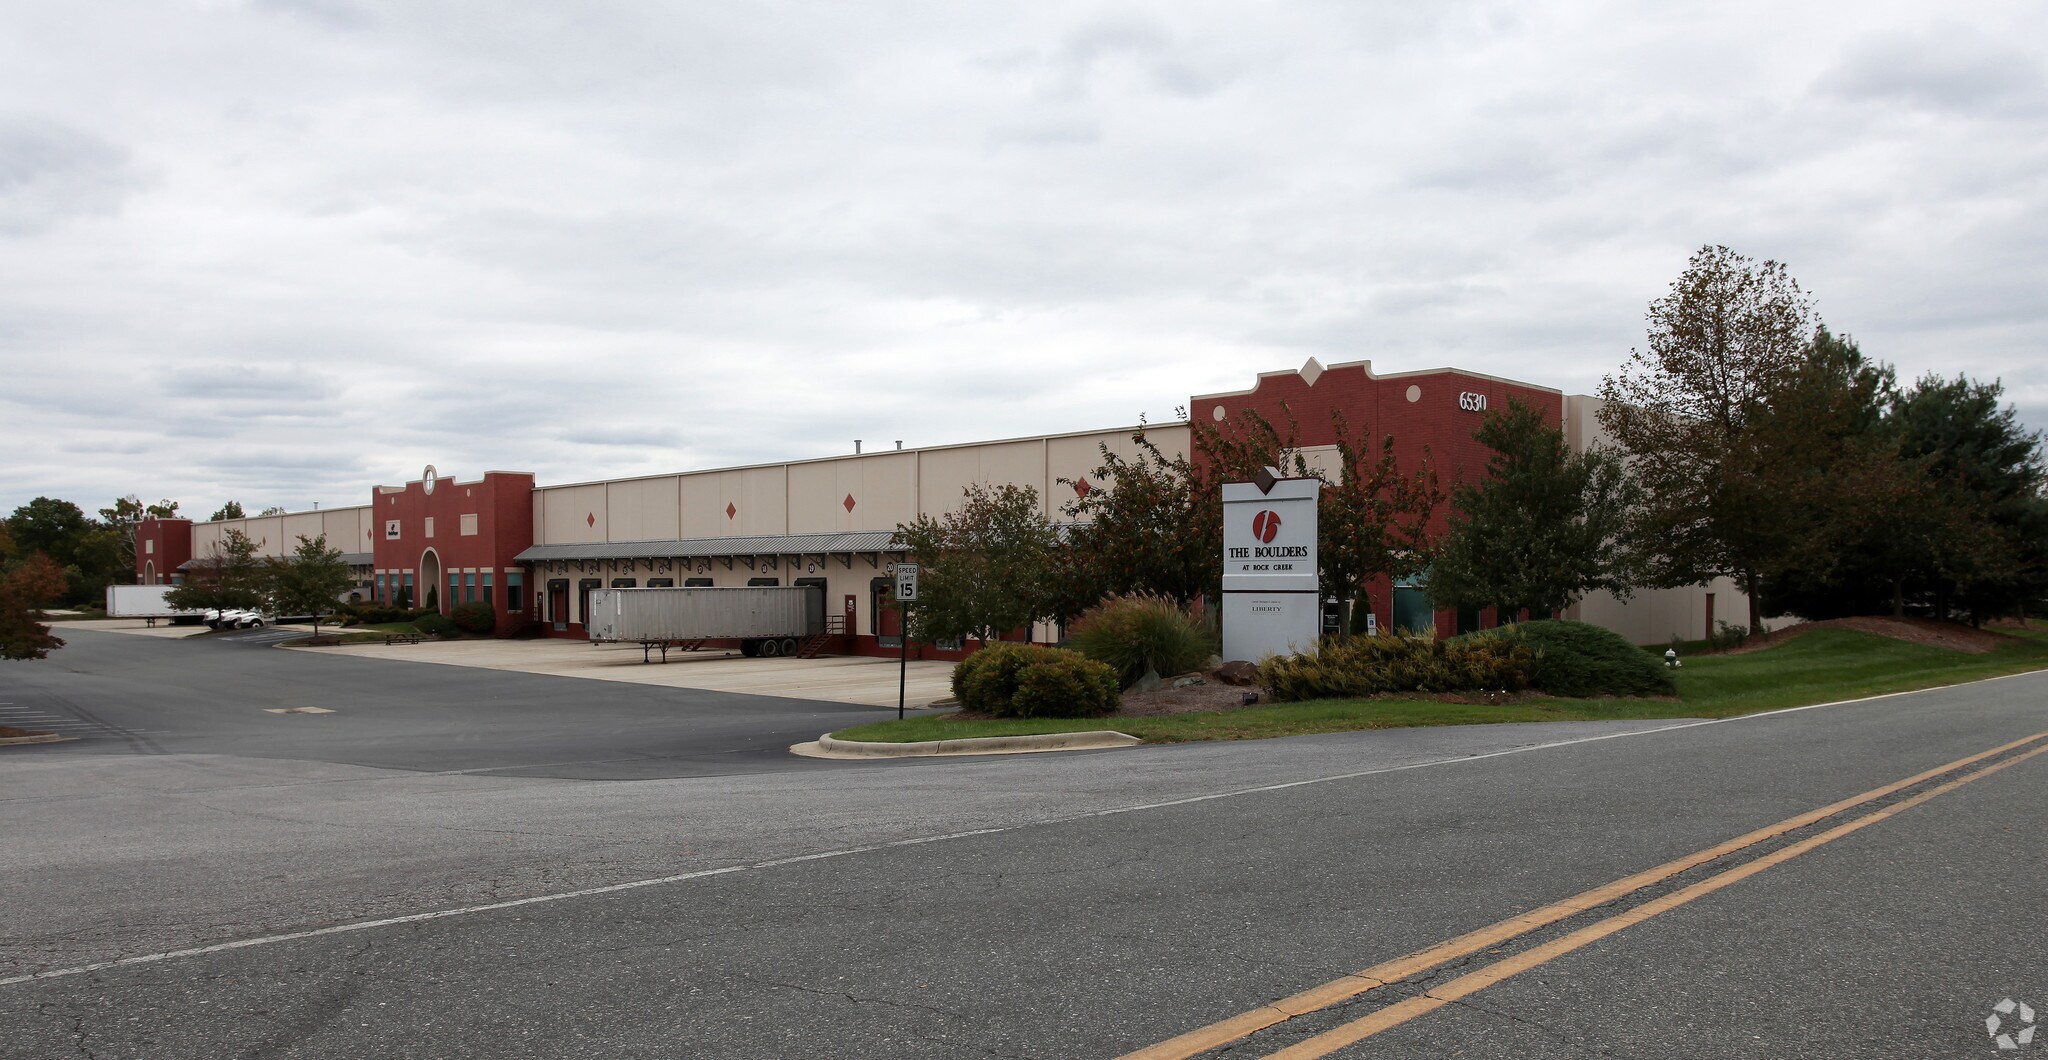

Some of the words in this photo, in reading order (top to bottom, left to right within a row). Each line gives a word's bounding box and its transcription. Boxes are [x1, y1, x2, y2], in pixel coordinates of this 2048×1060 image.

[1459, 391, 1487, 411] 6530
[1229, 547, 1250, 558] THE
[1255, 546, 1308, 558] BOULDERS
[900, 583, 913, 597] 15
